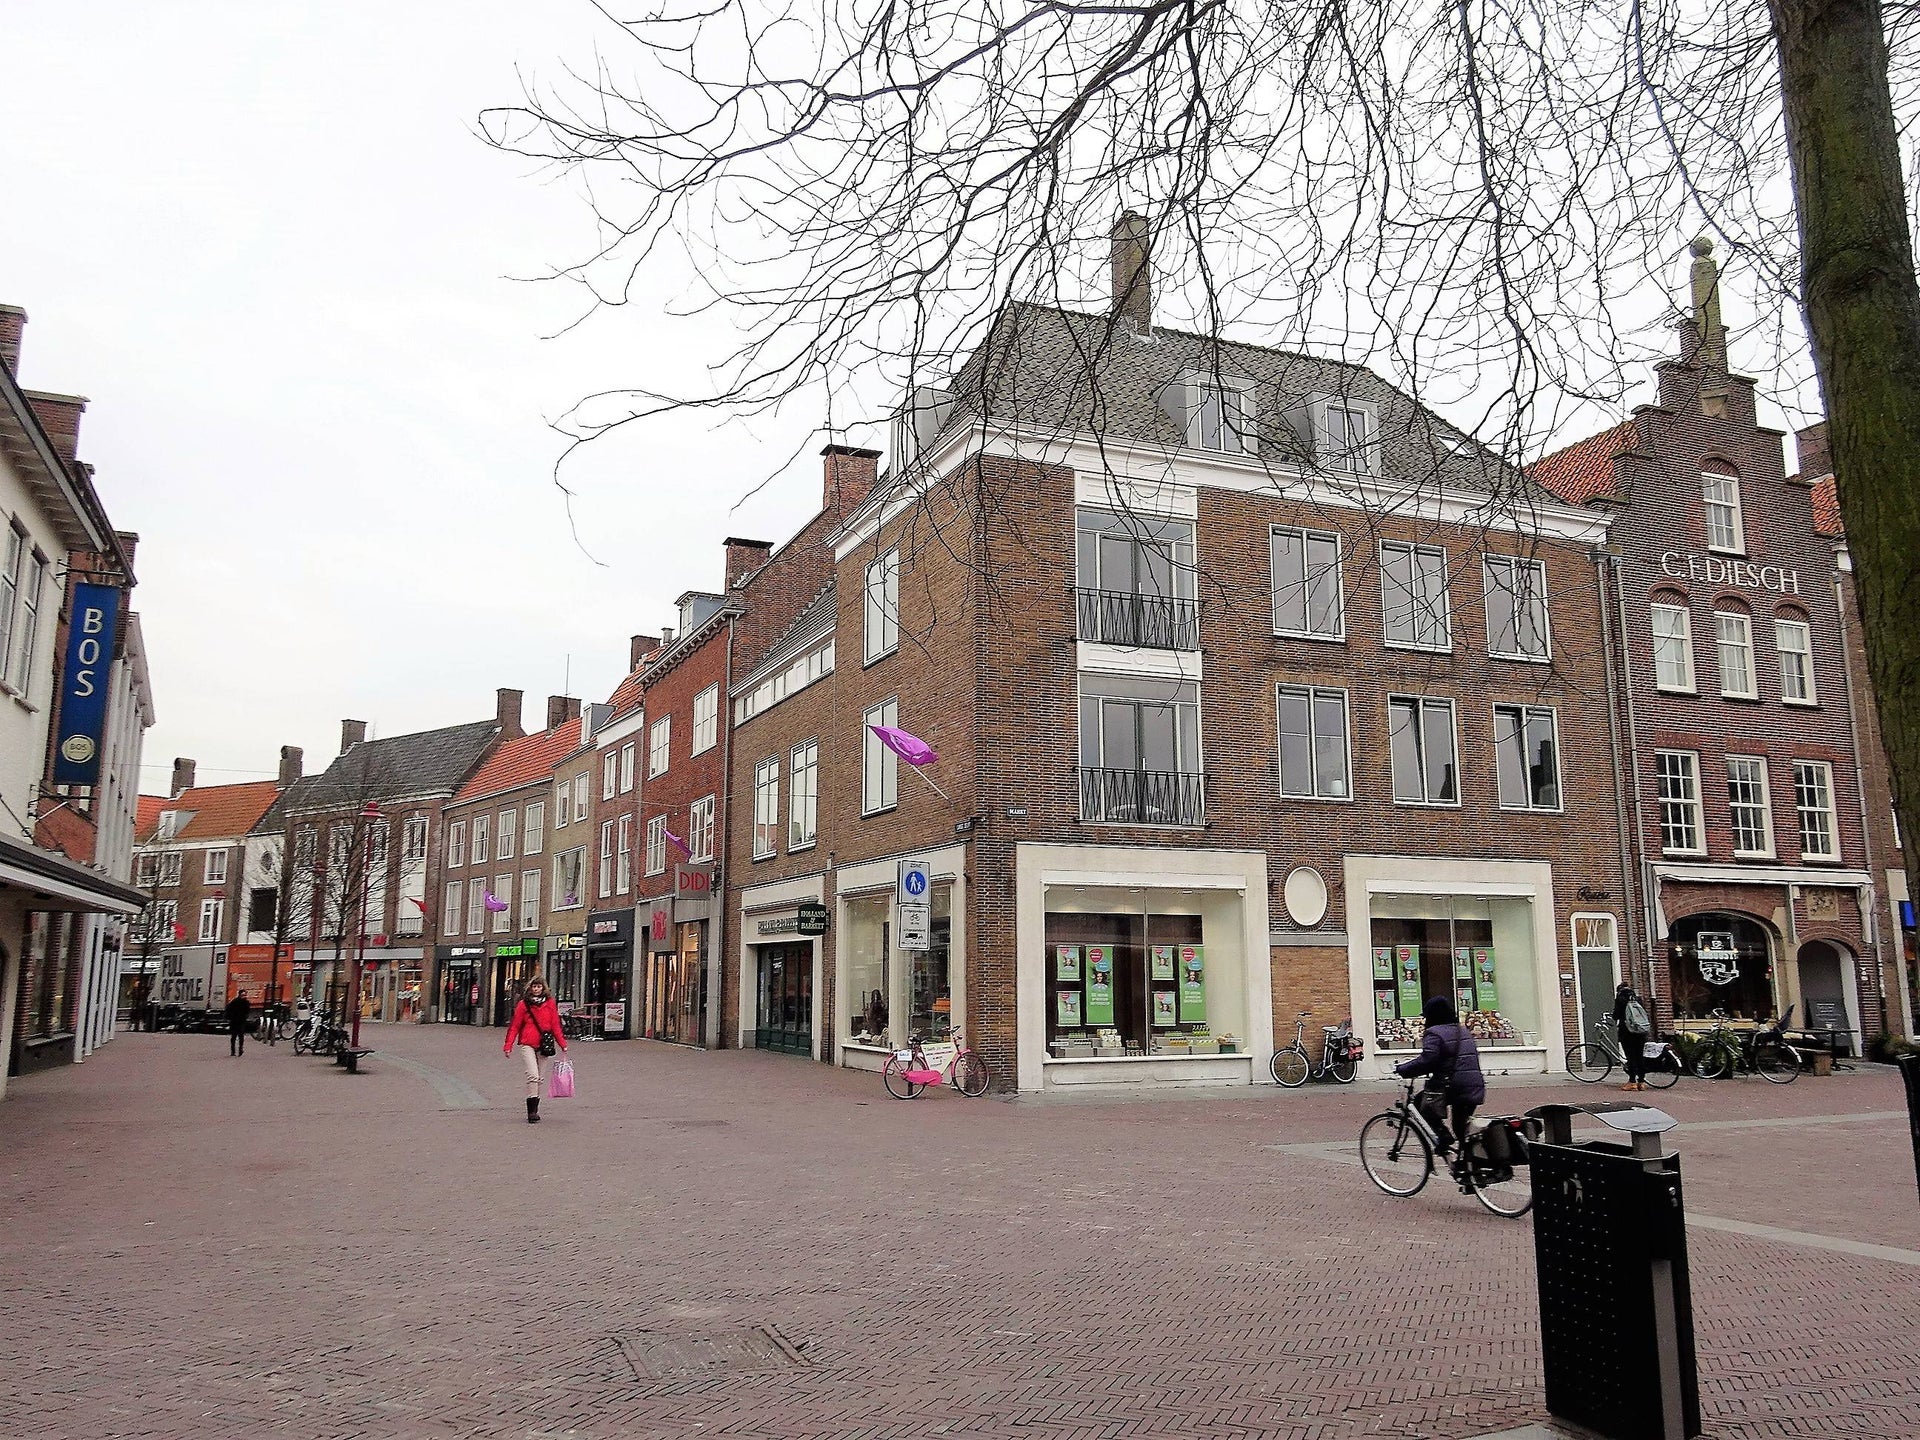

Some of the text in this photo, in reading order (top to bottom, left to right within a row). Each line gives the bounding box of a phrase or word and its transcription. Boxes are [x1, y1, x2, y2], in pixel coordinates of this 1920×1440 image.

[74, 608, 104, 697] BOS
[679, 871, 711, 891] DIDI
[800, 910, 826, 918] HOLLAND
[162, 954, 185, 977] FULL
[161, 978, 174, 1000] OF
[175, 977, 204, 1001] STYLE
